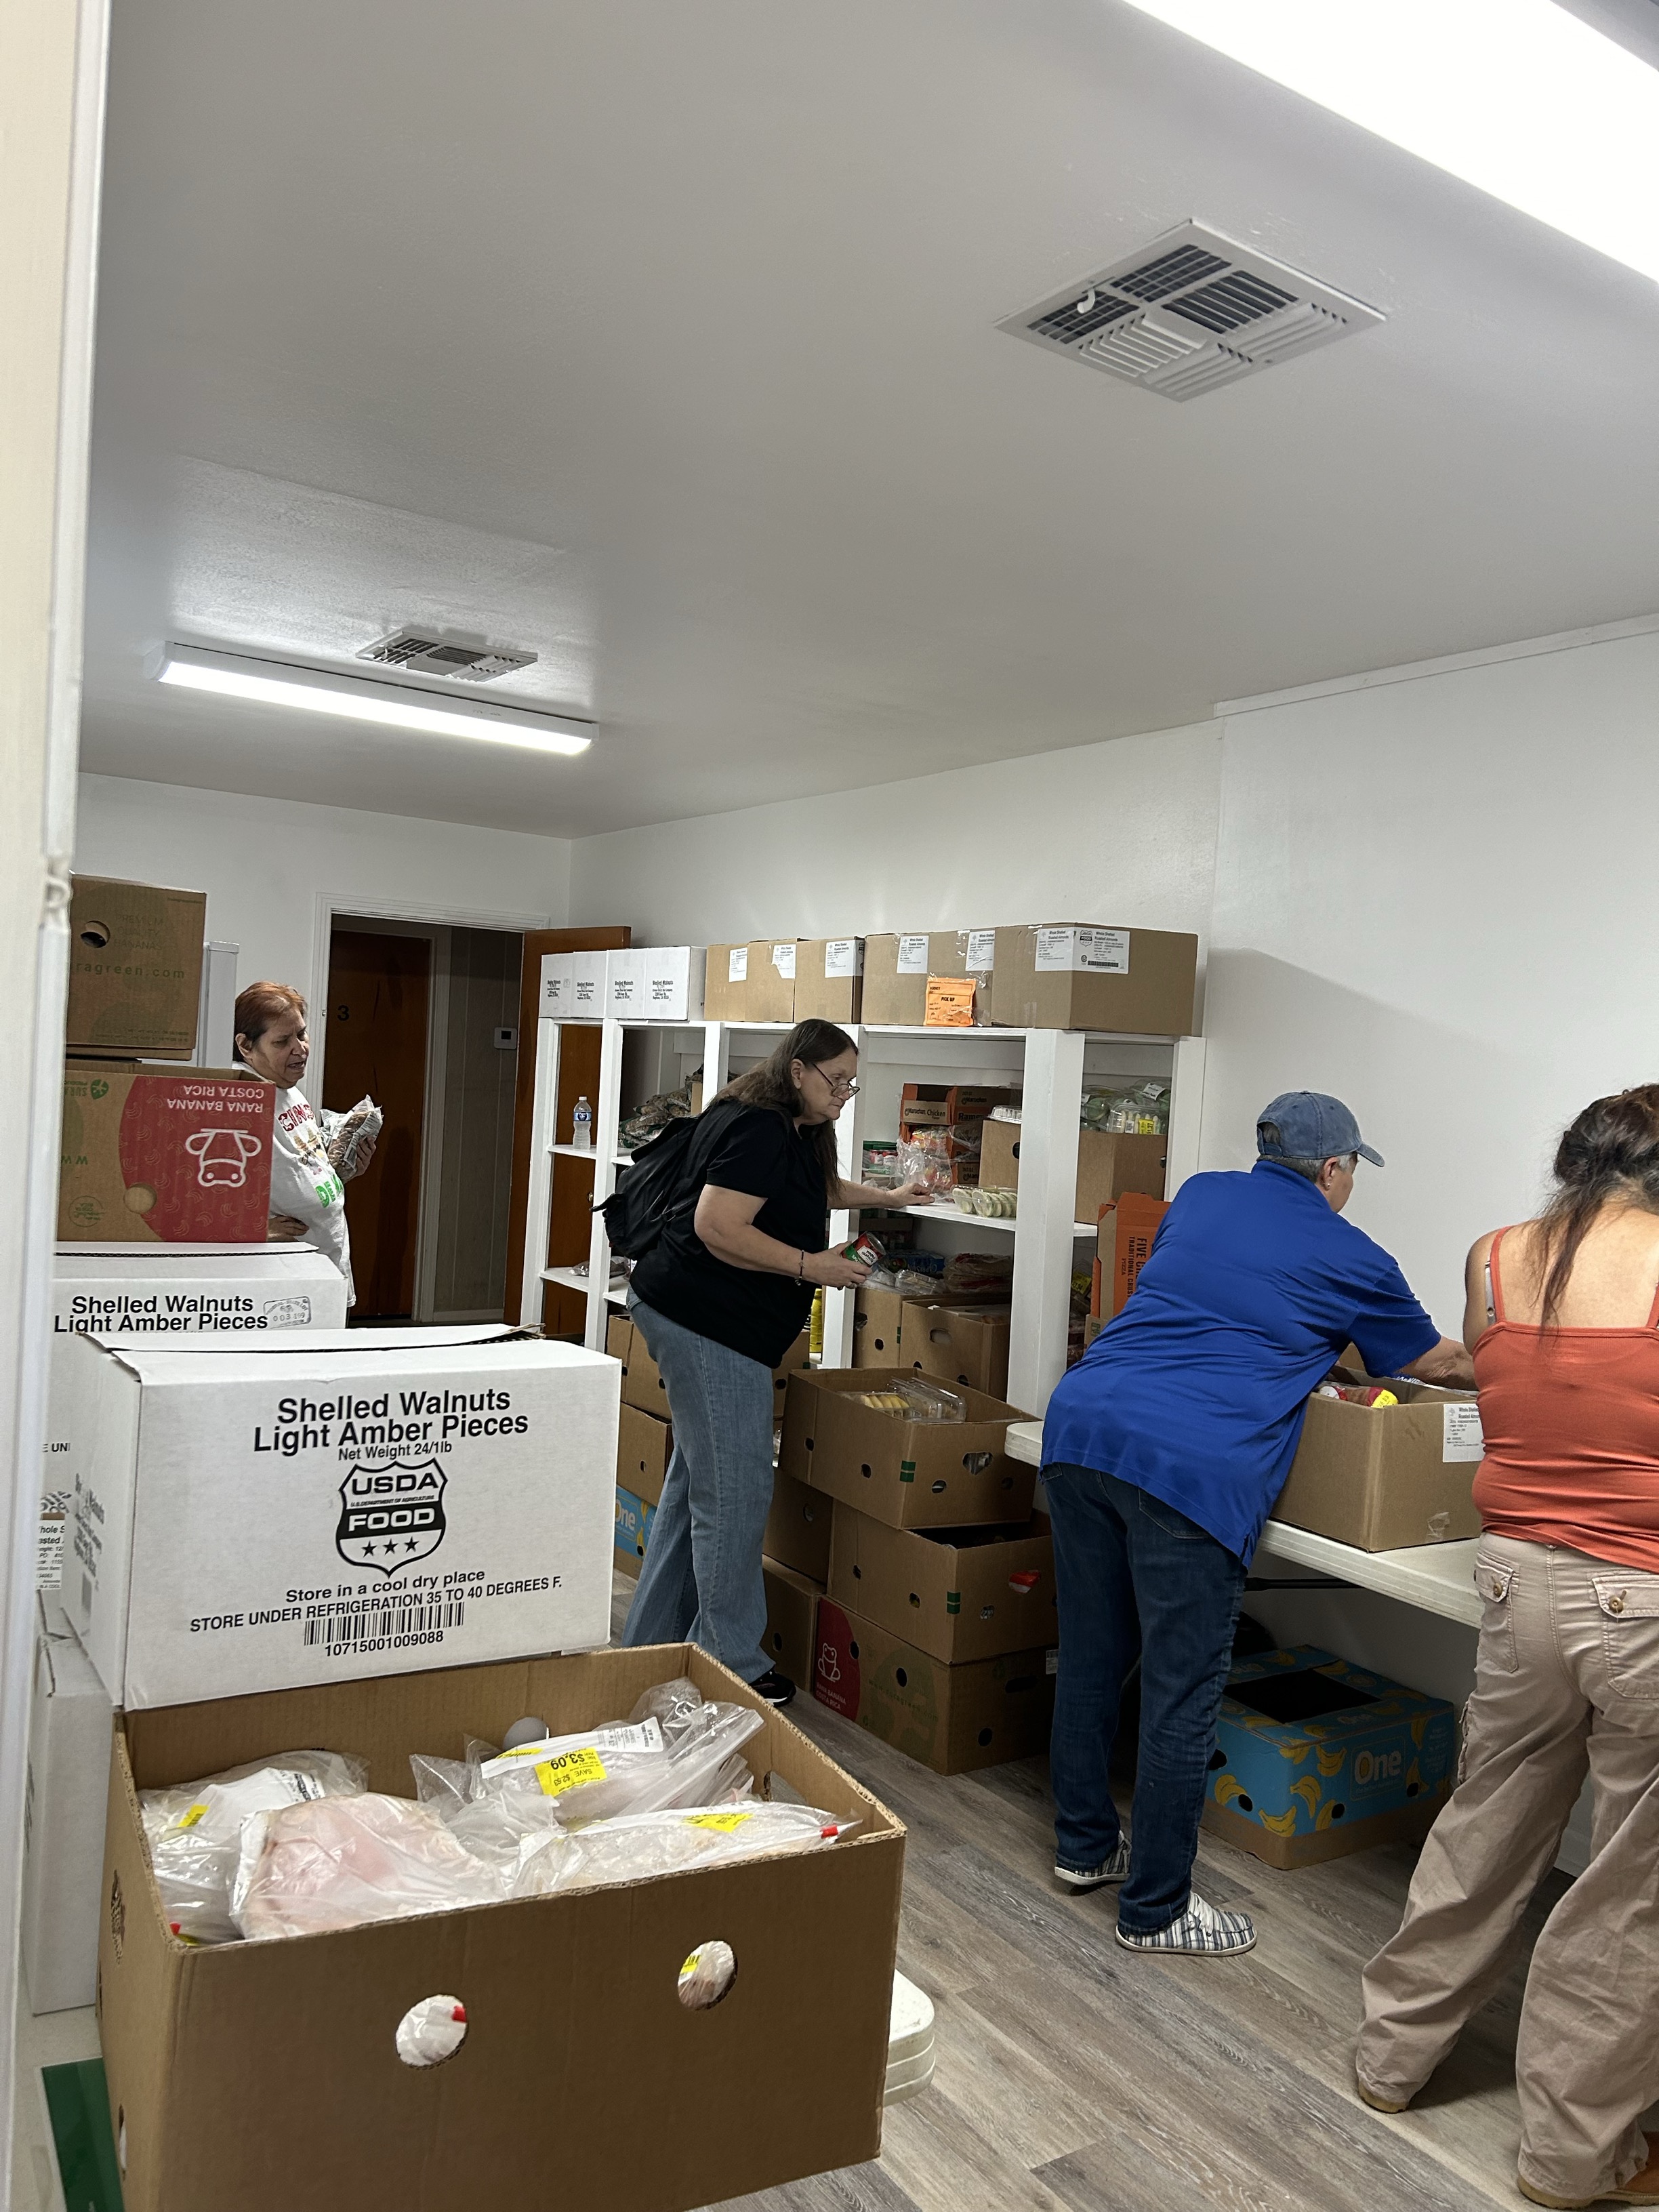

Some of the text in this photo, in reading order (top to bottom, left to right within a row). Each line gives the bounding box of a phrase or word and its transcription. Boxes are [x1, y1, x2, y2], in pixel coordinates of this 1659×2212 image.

[337, 1004, 350, 1021] 3
[183, 1086, 264, 1099] COSTA RICA
[167, 1099, 263, 1113] RANA BANANA
[1127, 1236, 1135, 1276] TRADITIONAL
[1136, 1237, 1147, 1258] FIVE
[71, 1295, 157, 1314] Shelled
[165, 1294, 253, 1313] Walnuts
[54, 1313, 268, 1333] Light Amber Pieces
[278, 1389, 511, 1424] Shelled Walnuts
[253, 1414, 529, 1457] Light Amber Pieces
[337, 1441, 452, 1461] Net Weight 24/1lb
[352, 1473, 438, 1496] USDA
[402, 1494, 435, 1502] AGRICULTURE
[348, 1507, 435, 1532] FOOD
[615, 1498, 636, 1532] One
[39, 1525, 58, 1533] hole
[285, 1570, 485, 1604] Store in a cool dry place
[190, 1576, 562, 1633] STORE UNDER REFRIGERATION 35 TO 40 DEGREES F.
[324, 1631, 444, 1658] 10715001009088
[827, 1689, 846, 1705] BANANA
[830, 1699, 841, 1711] RICA
[550, 1753, 585, 1770] $3.09
[1355, 1750, 1402, 1785] One
[574, 1768, 592, 1778] SAVE
